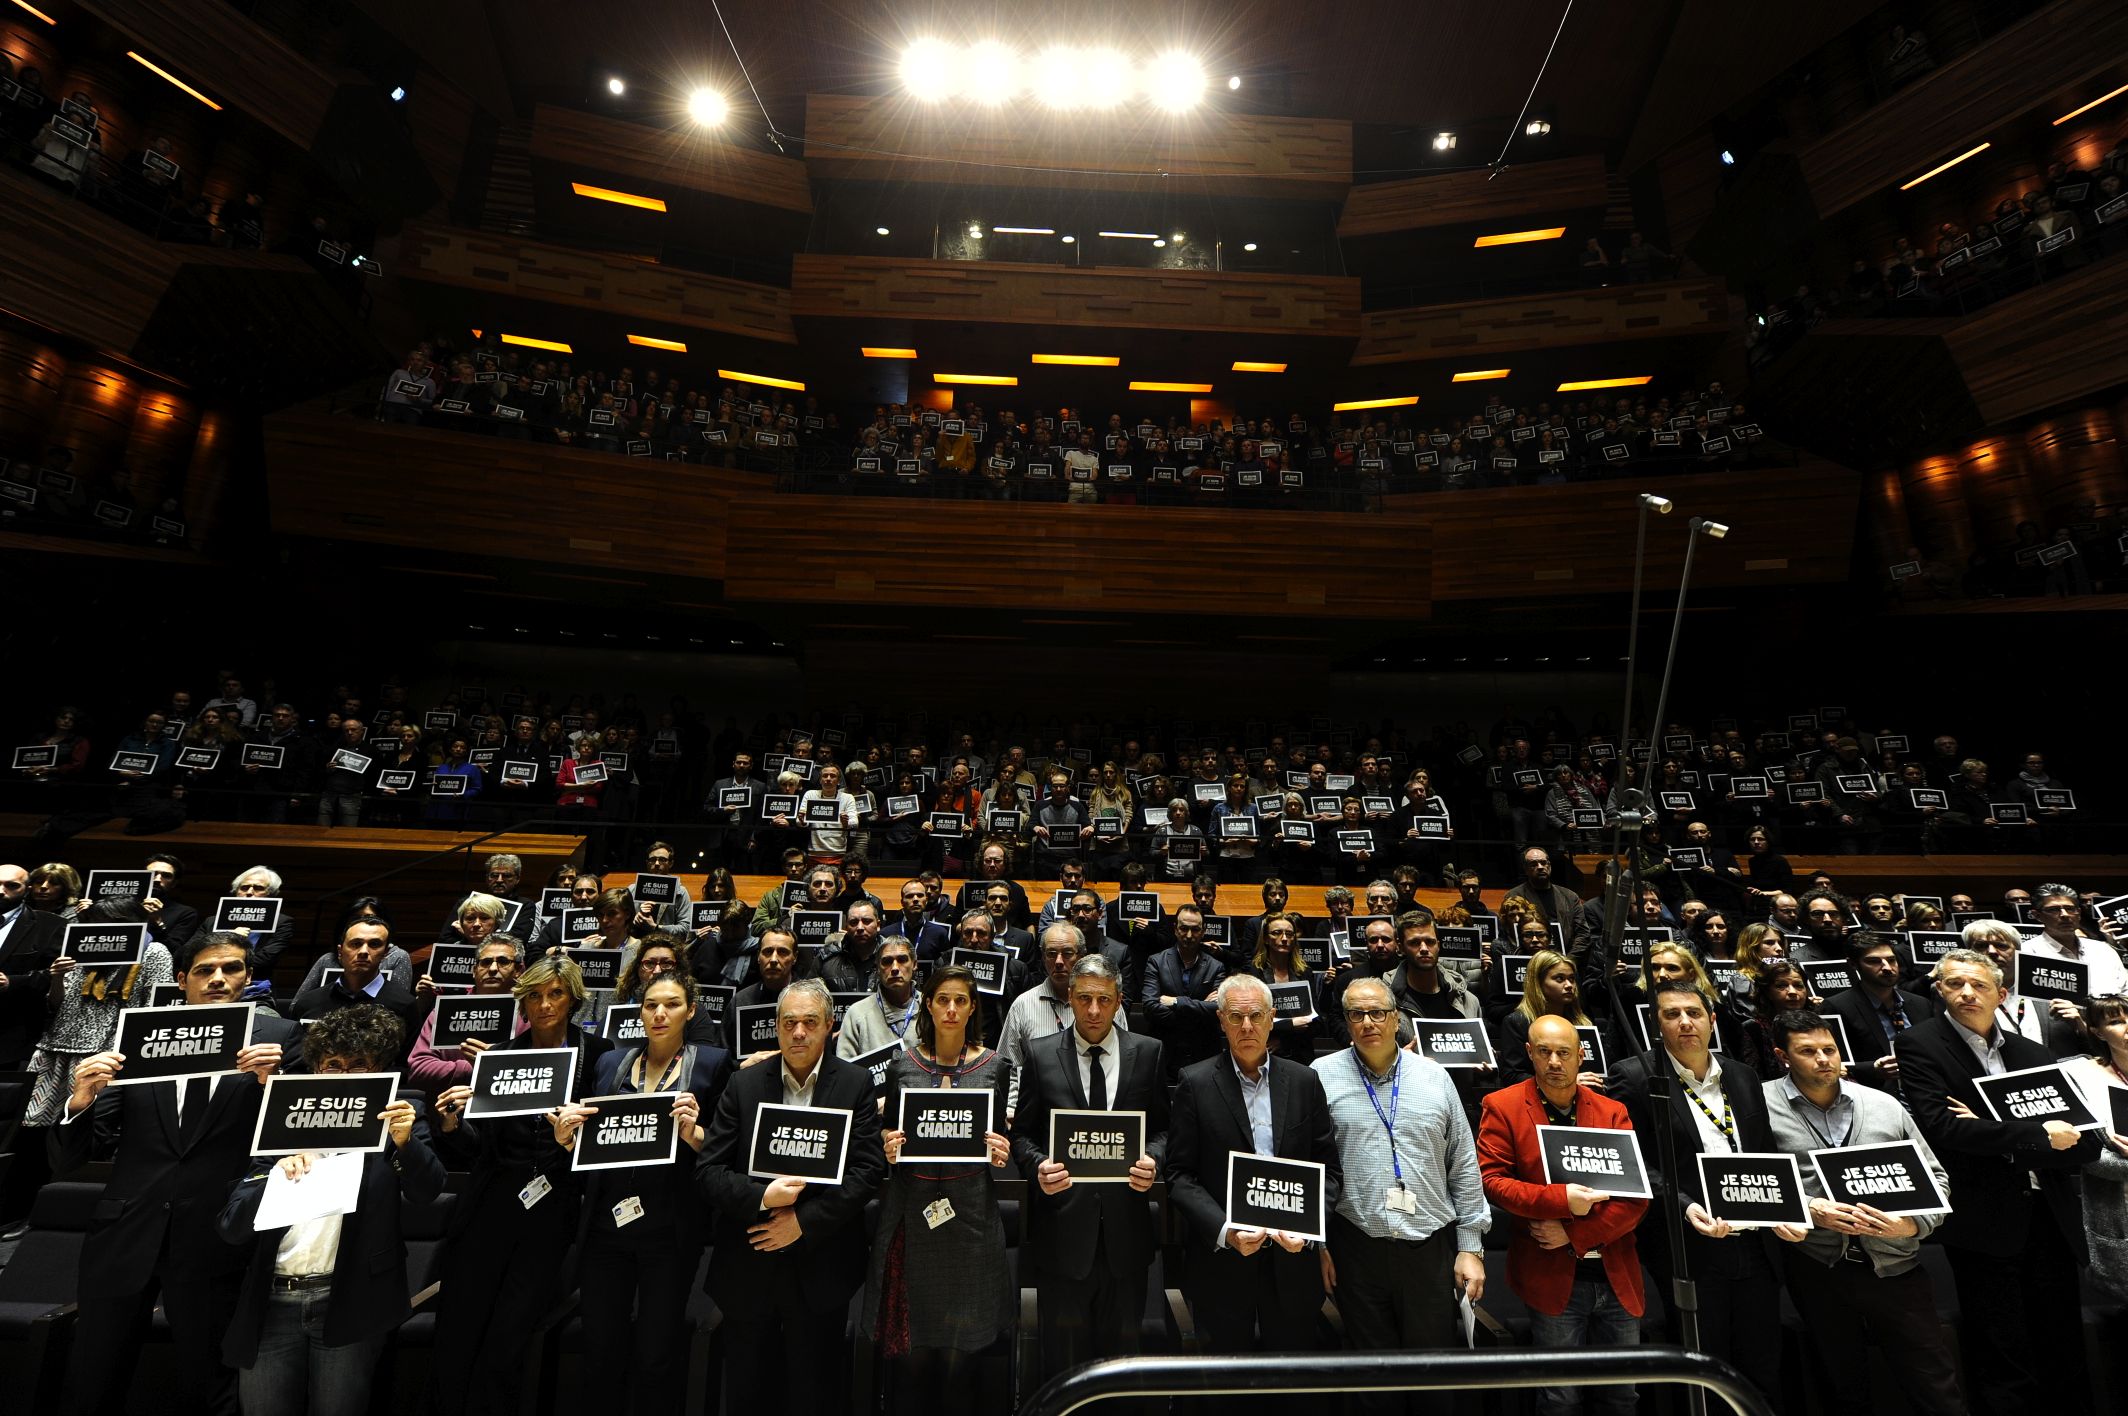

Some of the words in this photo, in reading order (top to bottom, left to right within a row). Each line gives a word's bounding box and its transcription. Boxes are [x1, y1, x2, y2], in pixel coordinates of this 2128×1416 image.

[99, 886, 139, 895] CHARLIE
[642, 887, 668, 895] CHARLIE
[1126, 904, 1151, 912] CHARLIE
[2113, 908, 2128, 917] JE
[227, 913, 265, 921] CHARLIE
[572, 922, 600, 931] CHARLI
[800, 927, 831, 935] CHARLIE
[79, 935, 96, 943] JE
[78, 942, 127, 952] CHARLIE
[974, 962, 995, 970] SUIS
[1814, 972, 1826, 980] JE
[1825, 971, 1847, 979] SUIS
[2032, 967, 2047, 976] JE
[2048, 969, 2078, 981] SUIS
[1815, 978, 1852, 989] CHARLIE
[2032, 975, 2079, 993] CHARLIE
[705, 995, 724, 1003] SUIS
[450, 1011, 468, 1020] JE
[469, 1009, 500, 1019] SUIS
[448, 1019, 500, 1032] CHARLIE
[620, 1019, 635, 1028] JE
[752, 1020, 766, 1029] JE
[144, 1028, 171, 1041] JE
[174, 1024, 225, 1039] SUIS
[1429, 1033, 1445, 1041] JE
[1444, 1033, 1472, 1041] SUIS
[141, 1037, 224, 1058] CHARLIE
[1431, 1041, 1476, 1052] CHARLIE
[492, 1069, 514, 1080] JE
[516, 1067, 553, 1079] SUIS
[490, 1078, 552, 1095] CHARLIE
[2005, 1092, 2024, 1104] JE
[2022, 1086, 2058, 1100] SUIS
[289, 1097, 316, 1110] JE
[318, 1096, 368, 1110] SUIS
[2009, 1096, 2071, 1119] CHARLIE
[285, 1110, 366, 1128] CHARLIE
[598, 1115, 619, 1128] JE
[621, 1113, 658, 1127] SUIS
[917, 1109, 936, 1121] JE
[938, 1109, 973, 1121] SUIS
[596, 1126, 657, 1145] CHARLIE
[771, 1126, 791, 1138] JE
[792, 1127, 828, 1141] SUIS
[916, 1122, 972, 1138] CHARLIE
[1068, 1131, 1088, 1143] JE
[1090, 1131, 1125, 1144] SUIS
[769, 1138, 827, 1159] CHARLIE
[1068, 1143, 1125, 1160] CHARLIE
[1560, 1145, 1581, 1156] JE
[1581, 1146, 1619, 1159] SUIS
[1561, 1156, 1624, 1175] CHARLIE
[1841, 1167, 1864, 1179] JE
[1863, 1163, 1906, 1177] SUIS
[1246, 1176, 1266, 1190] JE
[1268, 1179, 1304, 1195] SUIS
[1719, 1174, 1739, 1185] JE
[1740, 1174, 1778, 1186] SUIS
[1845, 1175, 1917, 1195] CHARLIE
[1246, 1189, 1304, 1213] CHARLIE
[1721, 1186, 1784, 1203] CHARLIE
